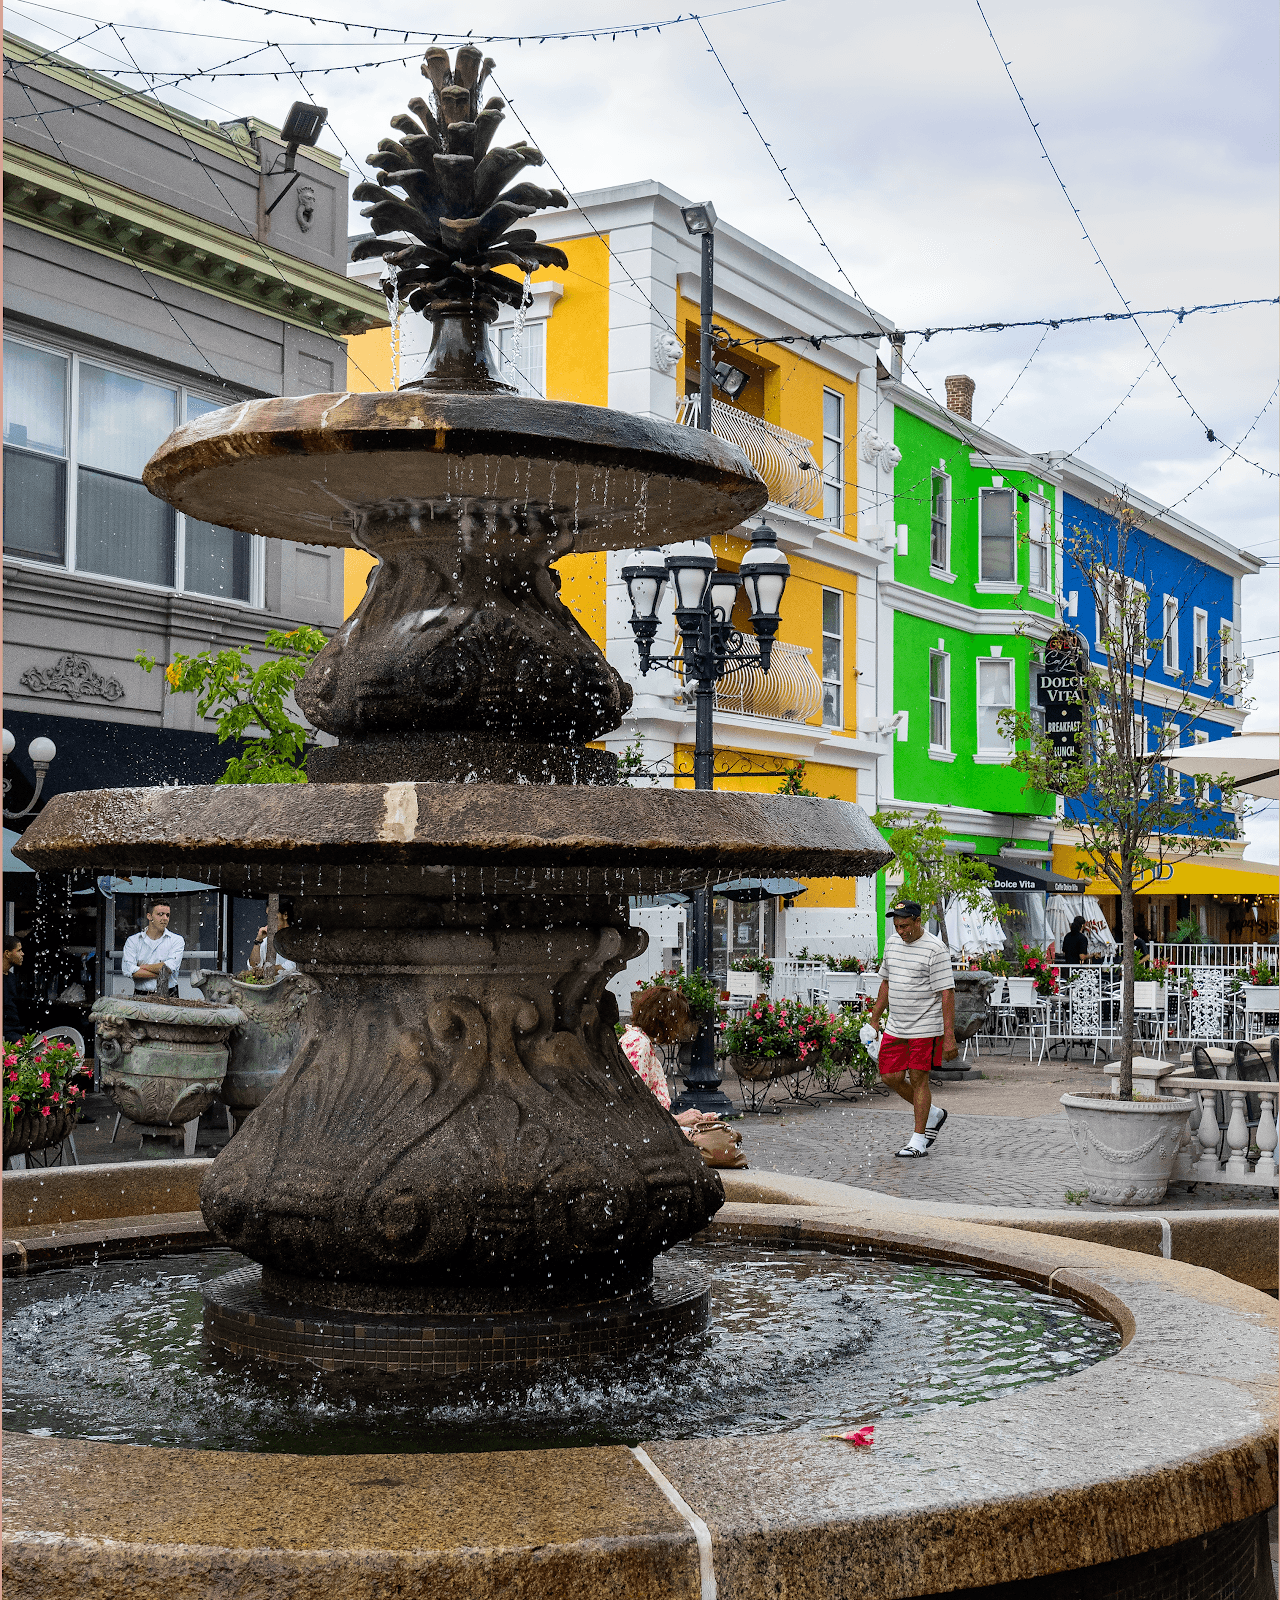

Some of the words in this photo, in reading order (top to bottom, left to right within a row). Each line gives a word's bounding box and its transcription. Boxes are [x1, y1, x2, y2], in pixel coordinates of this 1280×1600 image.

[1047, 690, 1081, 702] VITA
[1048, 721, 1081, 732] BREAKFAST
[1054, 746, 1075, 757] LUNCH
[994, 880, 1017, 888] Dolce
[1019, 880, 1036, 889] Vita
